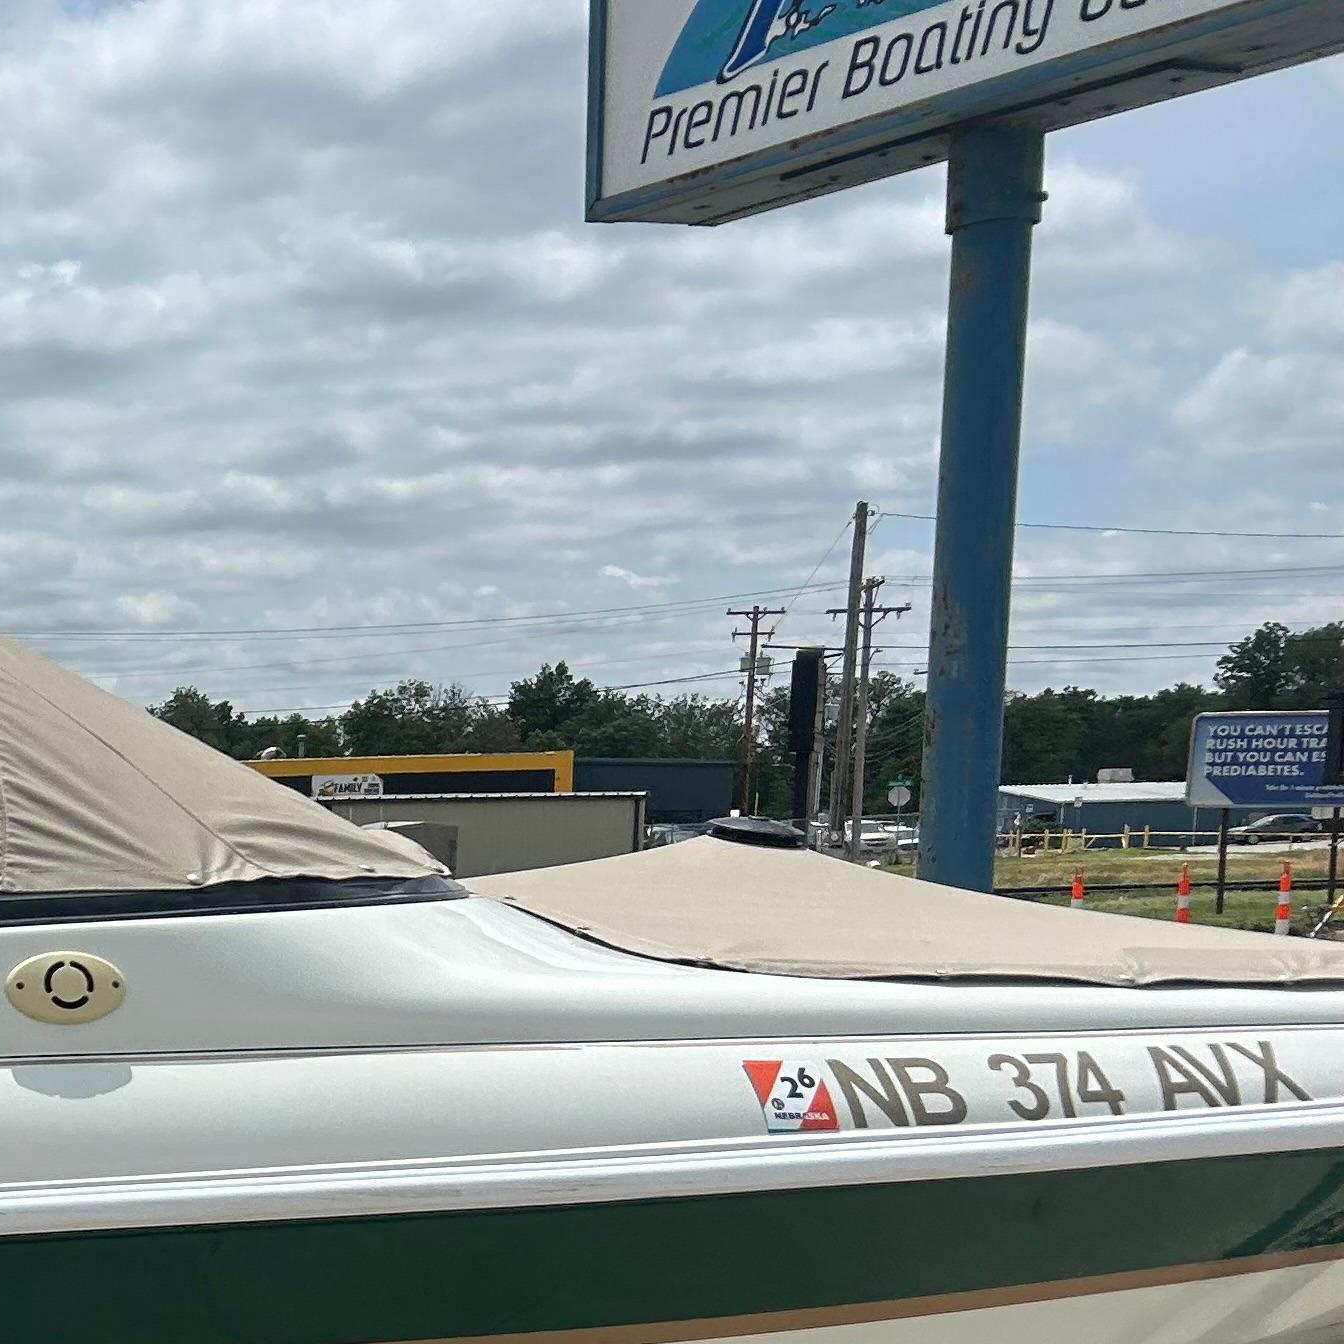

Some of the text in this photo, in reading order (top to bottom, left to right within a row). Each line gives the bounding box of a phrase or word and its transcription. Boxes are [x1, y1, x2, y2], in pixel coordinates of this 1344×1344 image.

[640, 60, 830, 164] Premier
[842, 0, 1055, 99] Boating
[1208, 724, 1242, 736] YOU
[1244, 724, 1292, 736] CAN'T
[1205, 738, 1248, 750] RUSH
[1251, 738, 1298, 749] HOUR
[1204, 751, 1233, 763] BUT
[1236, 751, 1272, 763] YOU
[1274, 751, 1309, 763] CAN
[1203, 764, 1305, 777] PREDIABETES.
[779, 1067, 816, 1099] 26
[825, 1041, 1314, 1129] NB 374 AVX
[774, 1111, 830, 1121] NEBRASKA
